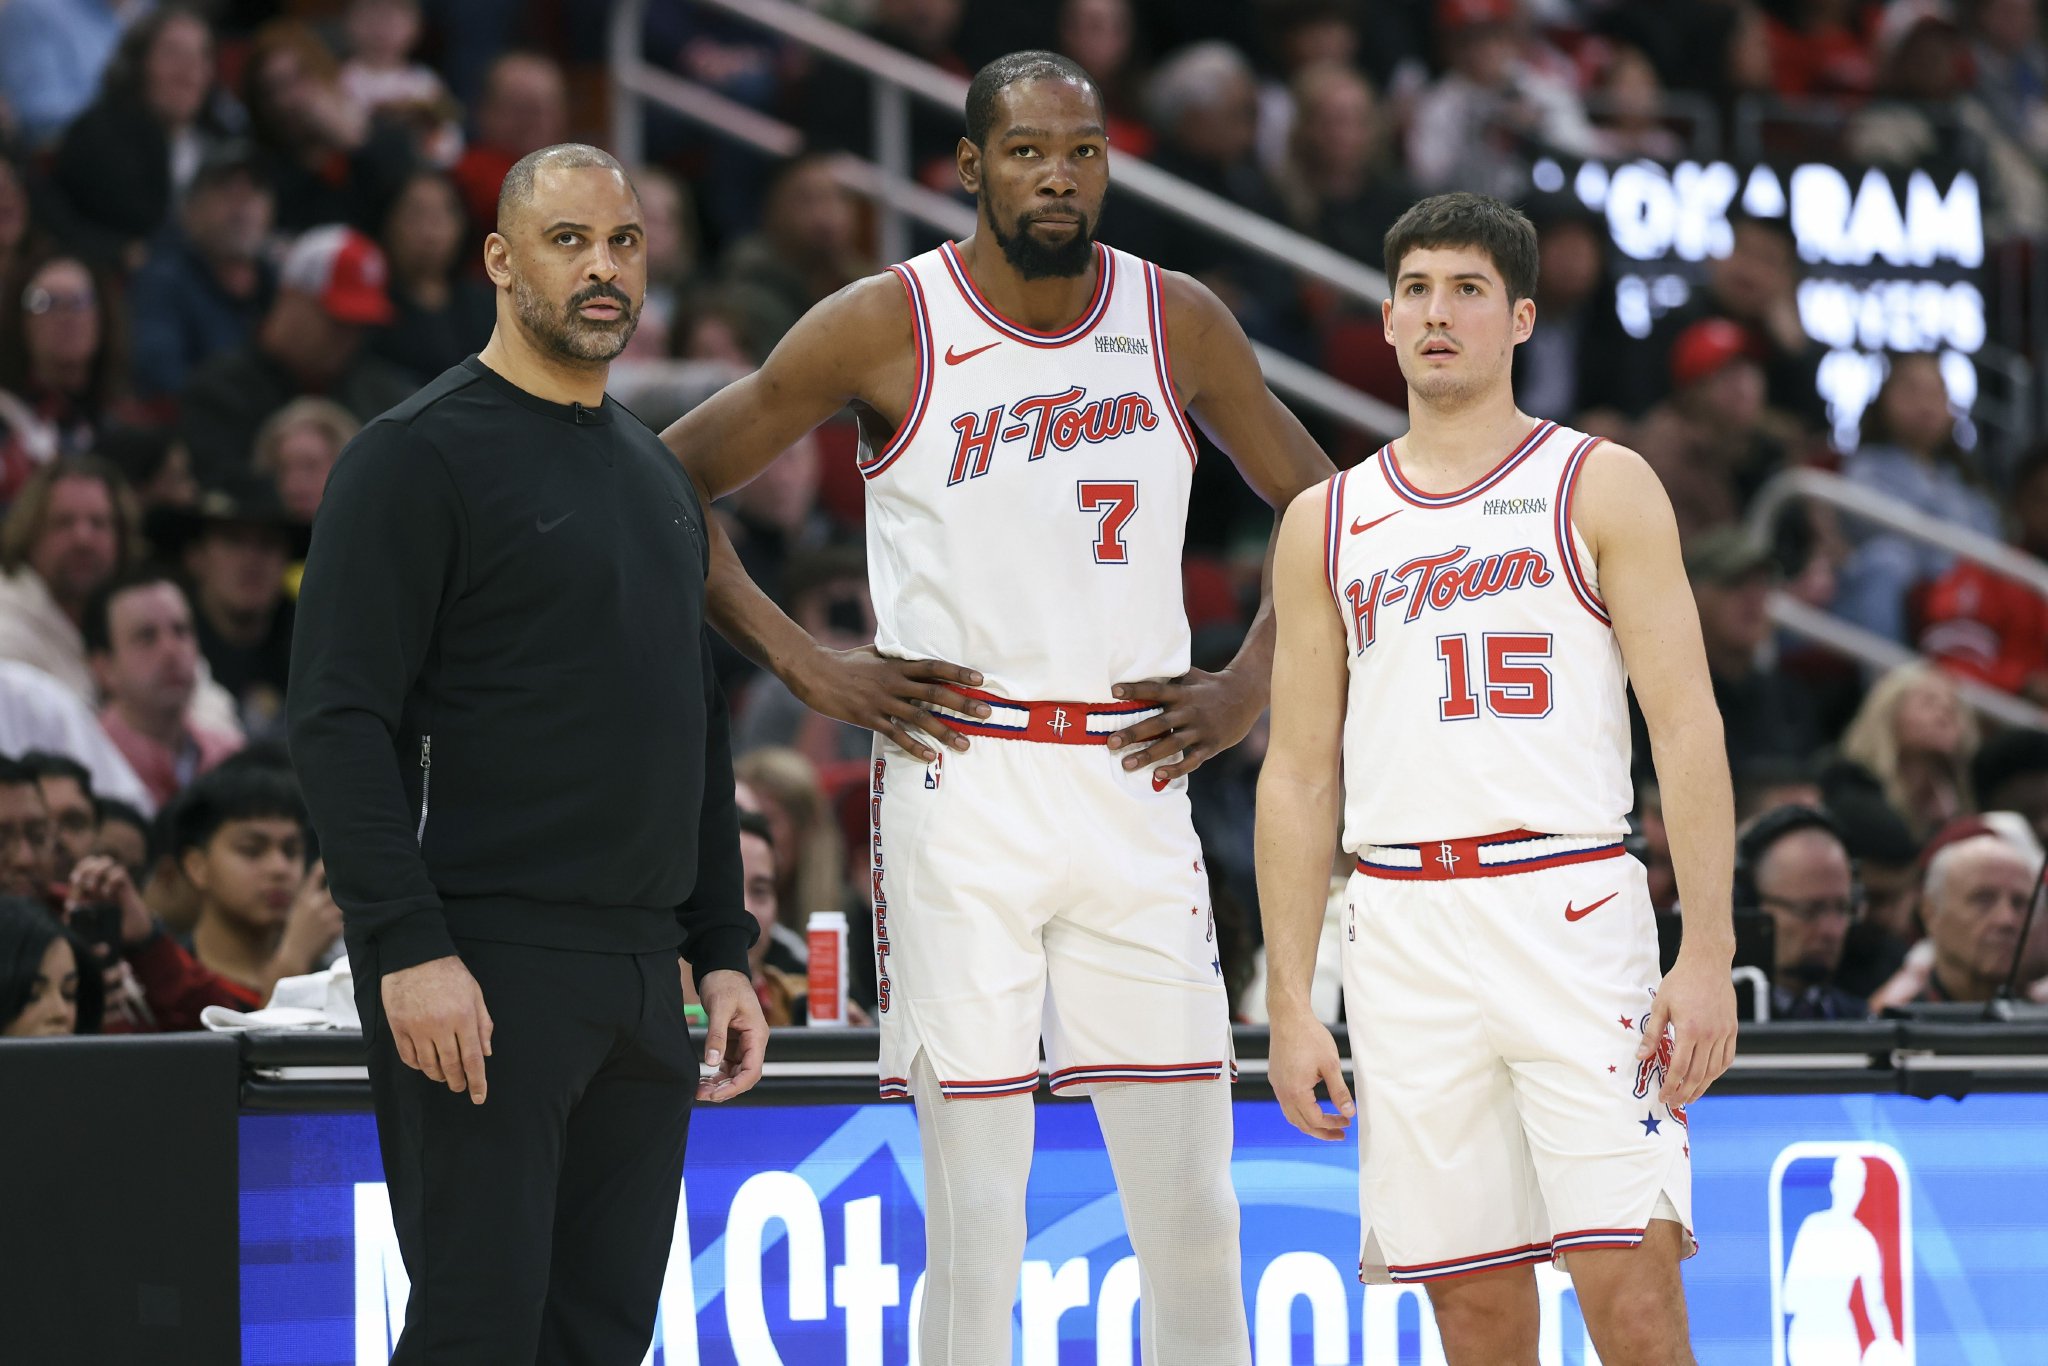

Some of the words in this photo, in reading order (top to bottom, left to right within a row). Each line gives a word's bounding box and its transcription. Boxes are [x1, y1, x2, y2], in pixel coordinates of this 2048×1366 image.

[1095, 335, 1148, 347] MEMORIAL
[1095, 343, 1148, 355] HERMANN
[946, 385, 1159, 487] H-Town
[1077, 480, 1139, 565] 7
[1483, 503, 1547, 515] HERMANN
[1484, 497, 1548, 508] MEMORIAL
[1345, 545, 1555, 658] H-Town
[1436, 632, 1553, 722] 15
[871, 758, 891, 1014] ROCKETS
